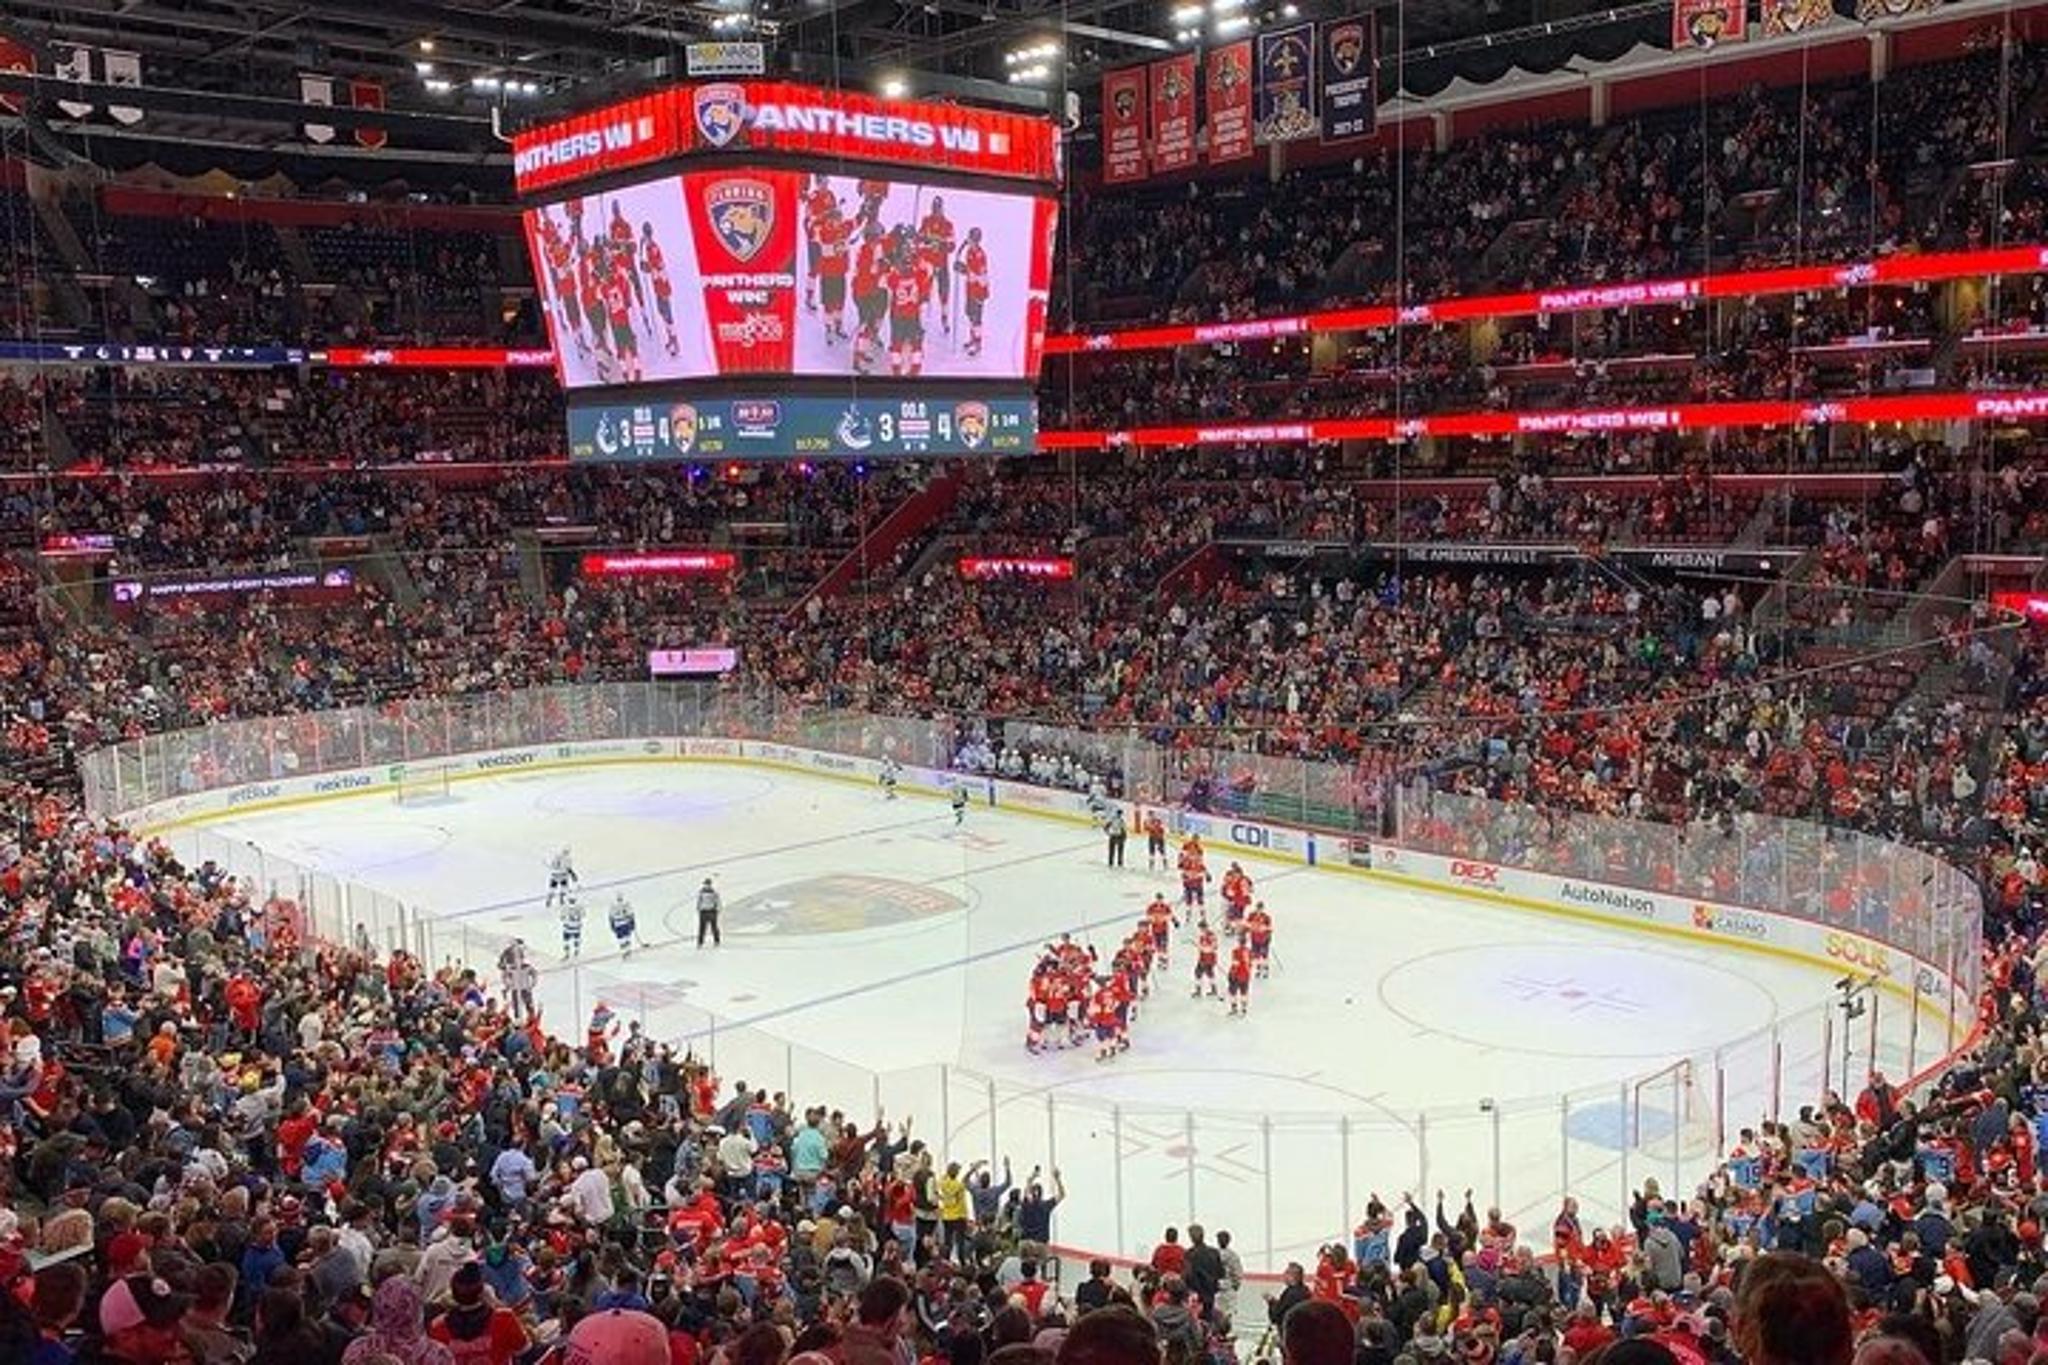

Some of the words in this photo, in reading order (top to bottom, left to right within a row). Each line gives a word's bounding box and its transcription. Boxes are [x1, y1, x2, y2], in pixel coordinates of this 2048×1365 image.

[620, 419, 632, 447] 3
[879, 413, 894, 442] 3
[938, 412, 950, 442] 4
[1407, 549, 1427, 561] THE
[477, 752, 534, 769] verizon
[1231, 823, 1269, 848] CDI
[1451, 860, 1498, 883] DEX
[1560, 882, 1656, 914] AutoNation
